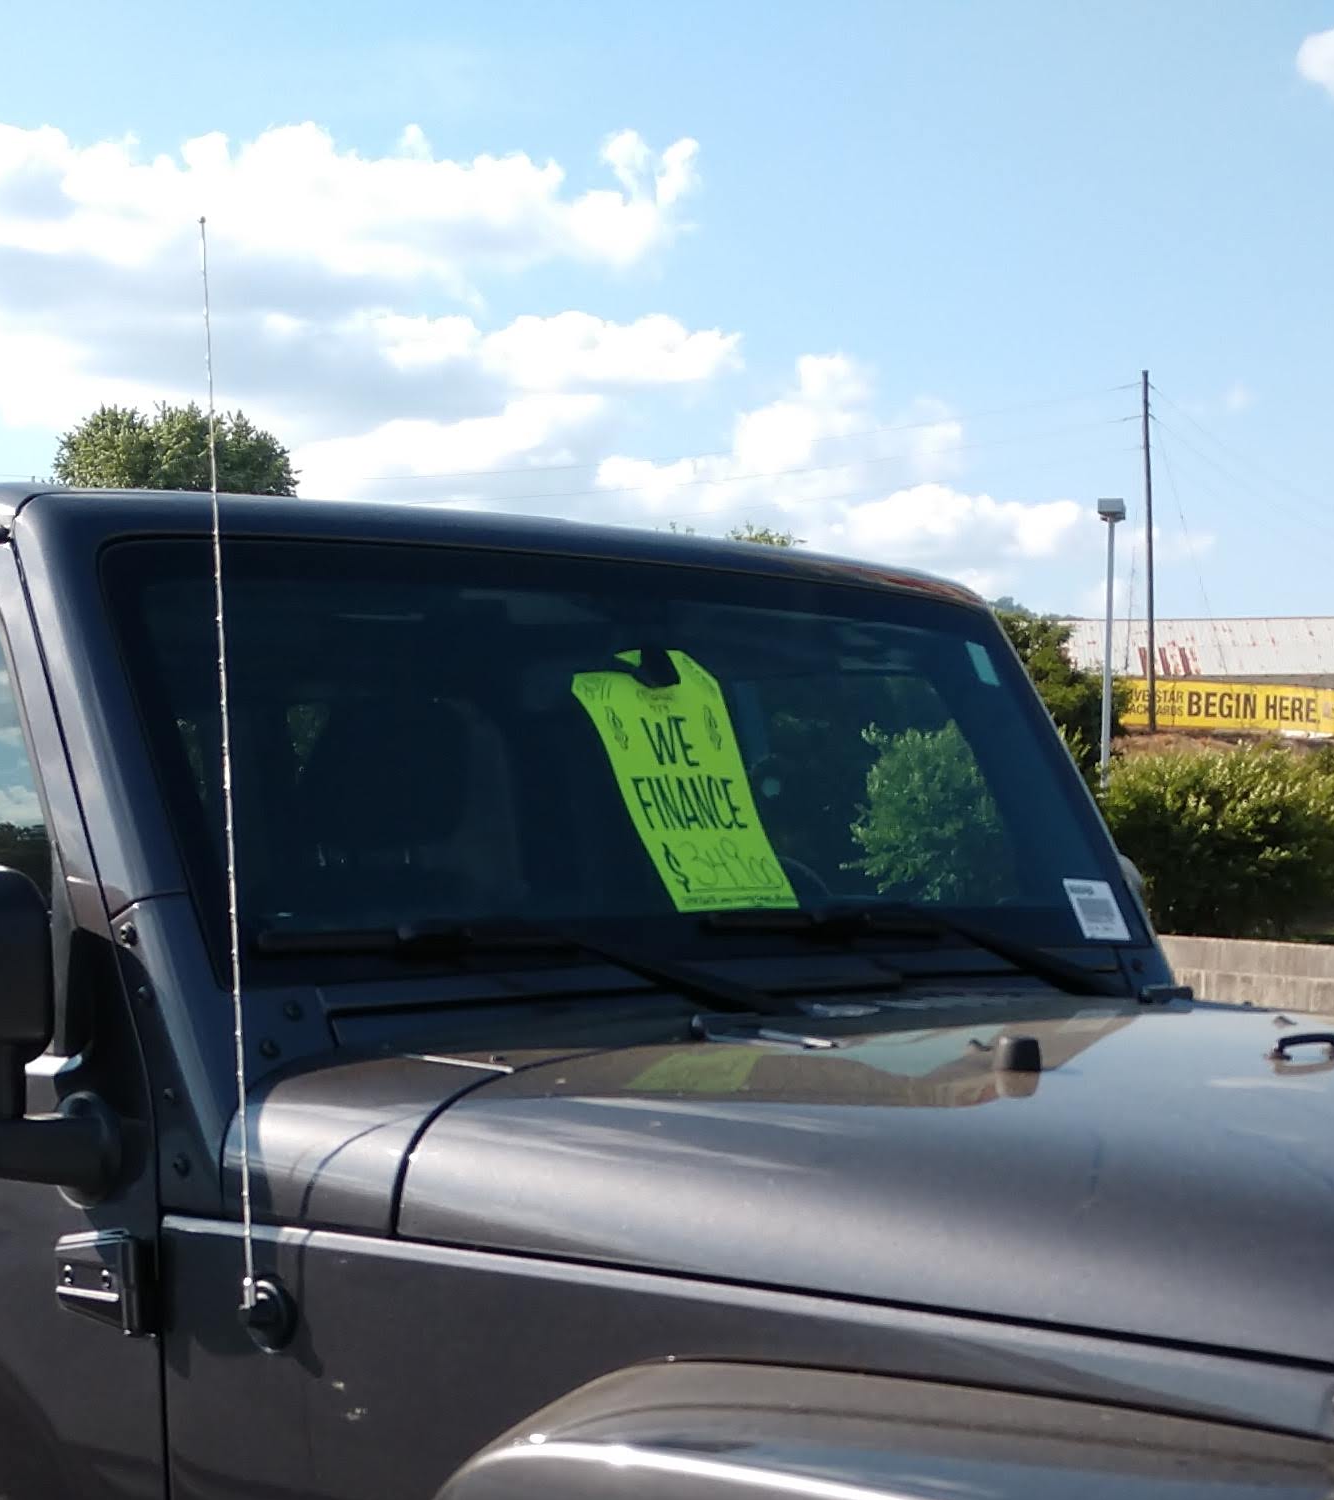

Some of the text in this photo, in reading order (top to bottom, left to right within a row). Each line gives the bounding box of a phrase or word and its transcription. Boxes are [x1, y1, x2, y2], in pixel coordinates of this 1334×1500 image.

[1187, 691, 1256, 719] BEGIN
[640, 715, 700, 767] WE
[630, 774, 748, 831] FINANCE
